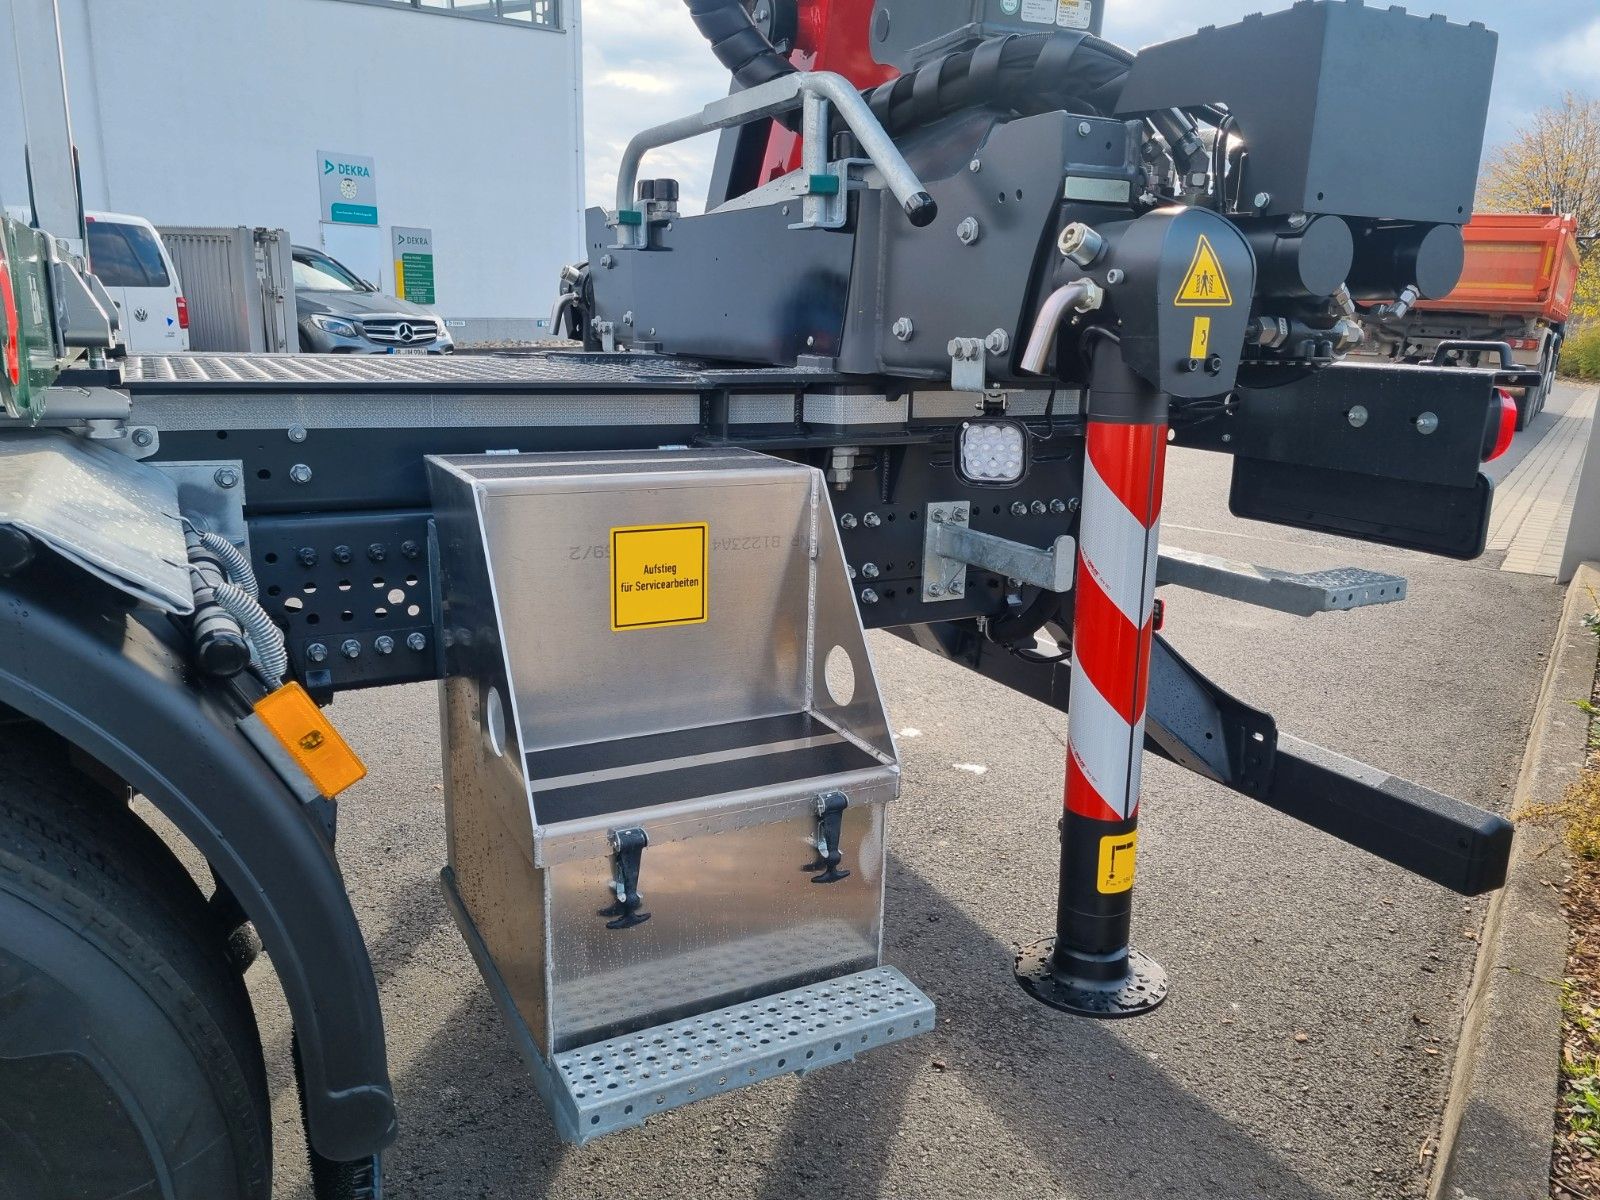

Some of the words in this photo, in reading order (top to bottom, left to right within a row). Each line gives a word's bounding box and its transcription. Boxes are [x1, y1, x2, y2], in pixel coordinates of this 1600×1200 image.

[338, 163, 370, 177] DEKRA
[406, 236, 428, 245] DEKRA
[643, 563, 677, 575] Aufstieg
[621, 581, 633, 593] für
[636, 577, 699, 592] Servicearbeiten
